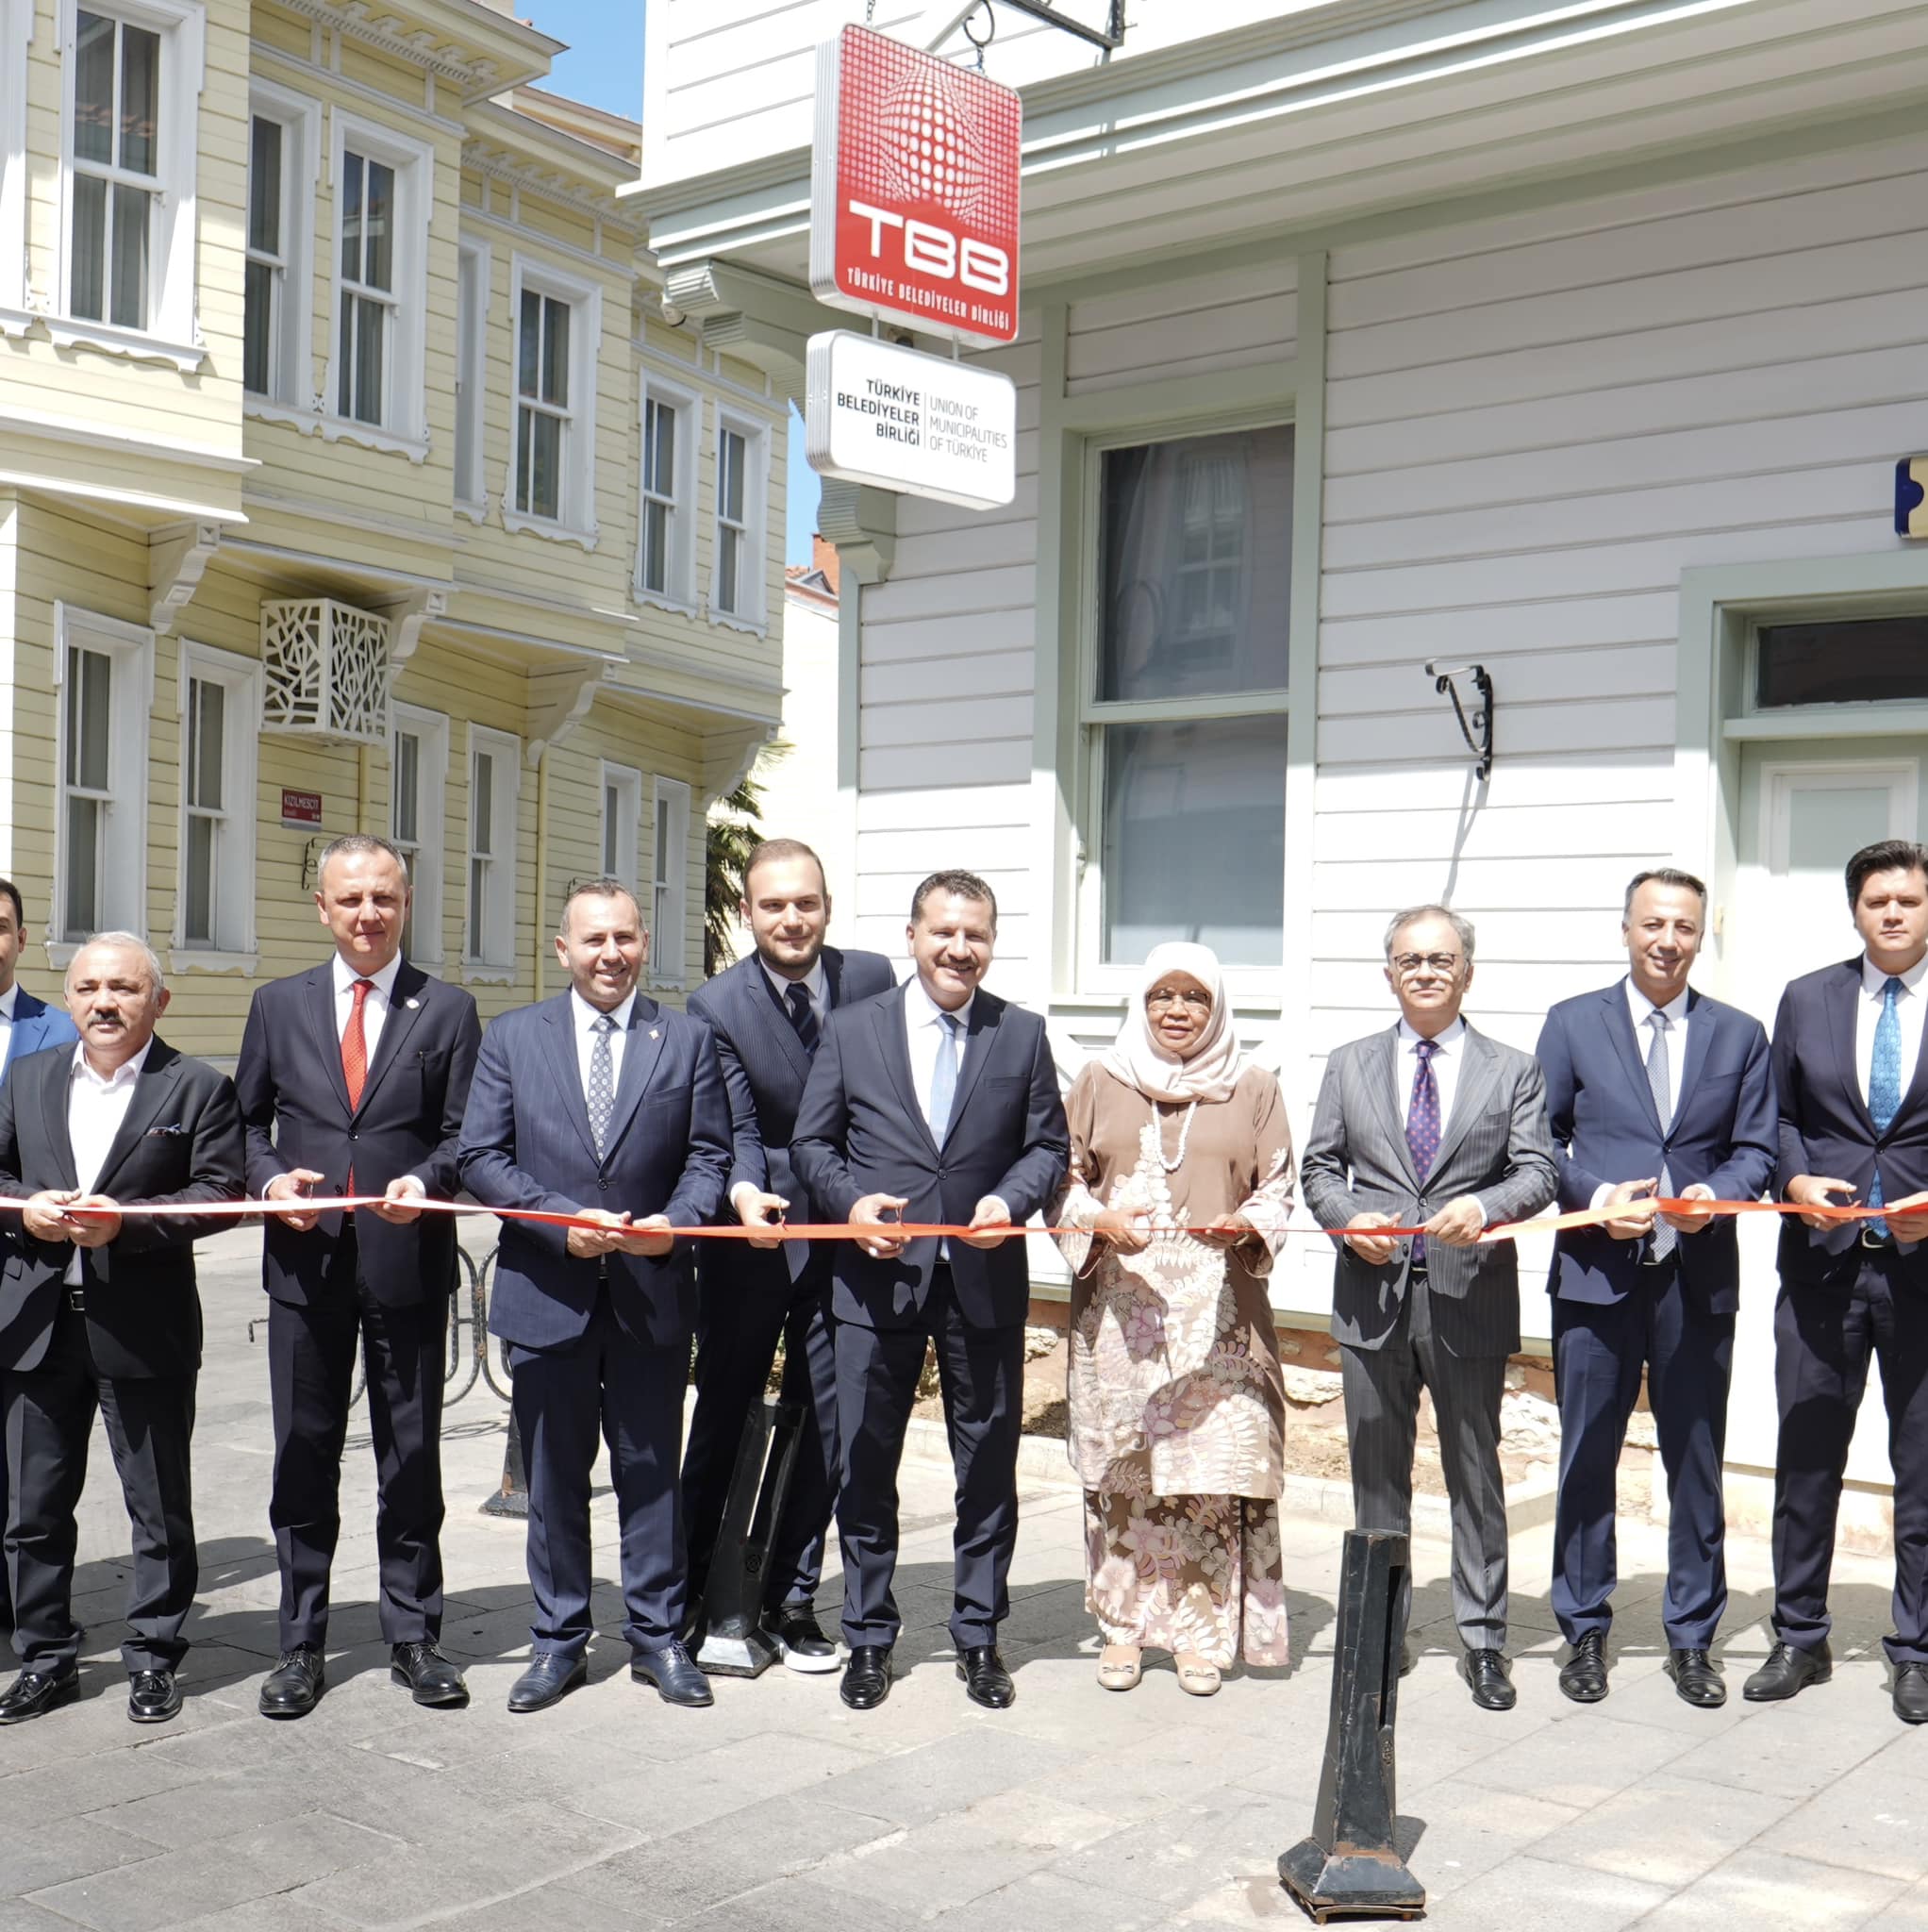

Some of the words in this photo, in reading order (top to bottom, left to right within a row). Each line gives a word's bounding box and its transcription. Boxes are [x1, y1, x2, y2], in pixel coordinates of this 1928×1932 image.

[849, 199, 1009, 296] TBB
[847, 267, 894, 297] TÜRKİYE
[898, 283, 968, 318] BELEDİYELER
[971, 304, 1009, 331] BİRLİĞİ
[866, 377, 921, 407] TÜRKİYE
[930, 394, 963, 418] UNION
[965, 405, 979, 421] OF
[838, 391, 920, 426] BELEDİYELER
[876, 421, 920, 446] BİRLİĞİ
[929, 415, 1007, 449] MUNICIPALITIES
[929, 435, 944, 451] OF
[945, 438, 988, 462] TÜRKİYE
